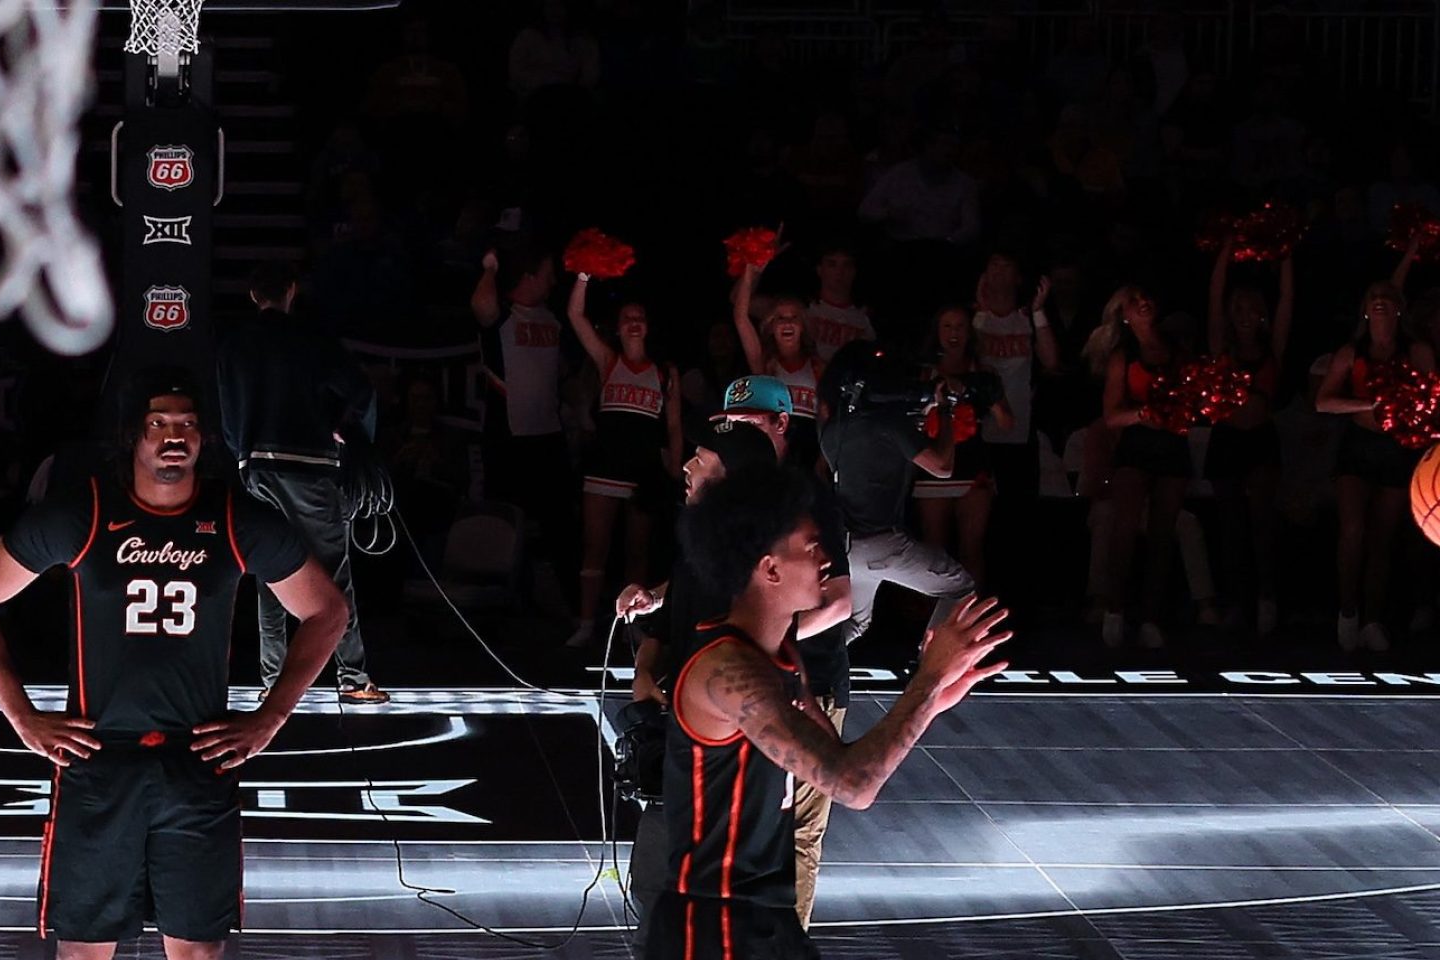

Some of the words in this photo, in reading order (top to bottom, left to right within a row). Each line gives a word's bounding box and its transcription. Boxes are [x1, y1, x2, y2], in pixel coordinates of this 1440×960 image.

[154, 151, 187, 159] PHILLIPS
[156, 163, 185, 180] 66
[150, 292, 184, 301] PHILLIPS
[153, 305, 182, 321] 66
[116, 536, 208, 571] Cowboys
[124, 577, 198, 636] 23
